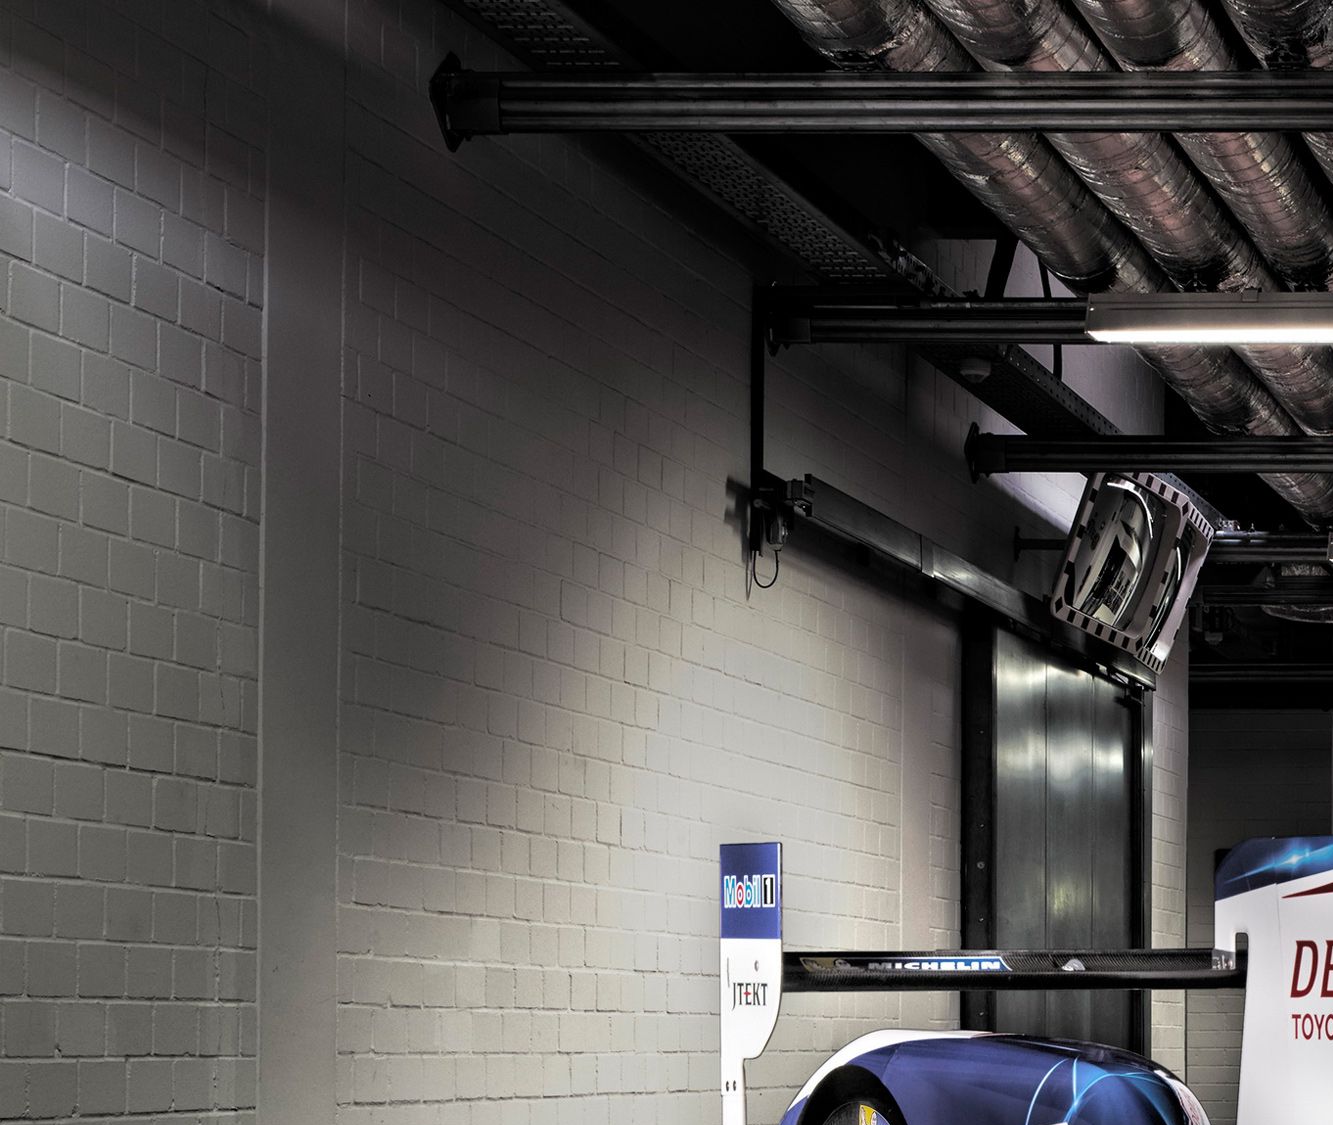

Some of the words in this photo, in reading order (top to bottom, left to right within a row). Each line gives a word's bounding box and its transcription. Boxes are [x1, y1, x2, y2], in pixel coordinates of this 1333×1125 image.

[724, 875, 760, 908] Mobil
[868, 961, 1001, 971] MICHELIN
[732, 982, 768, 1010] JTEKT
